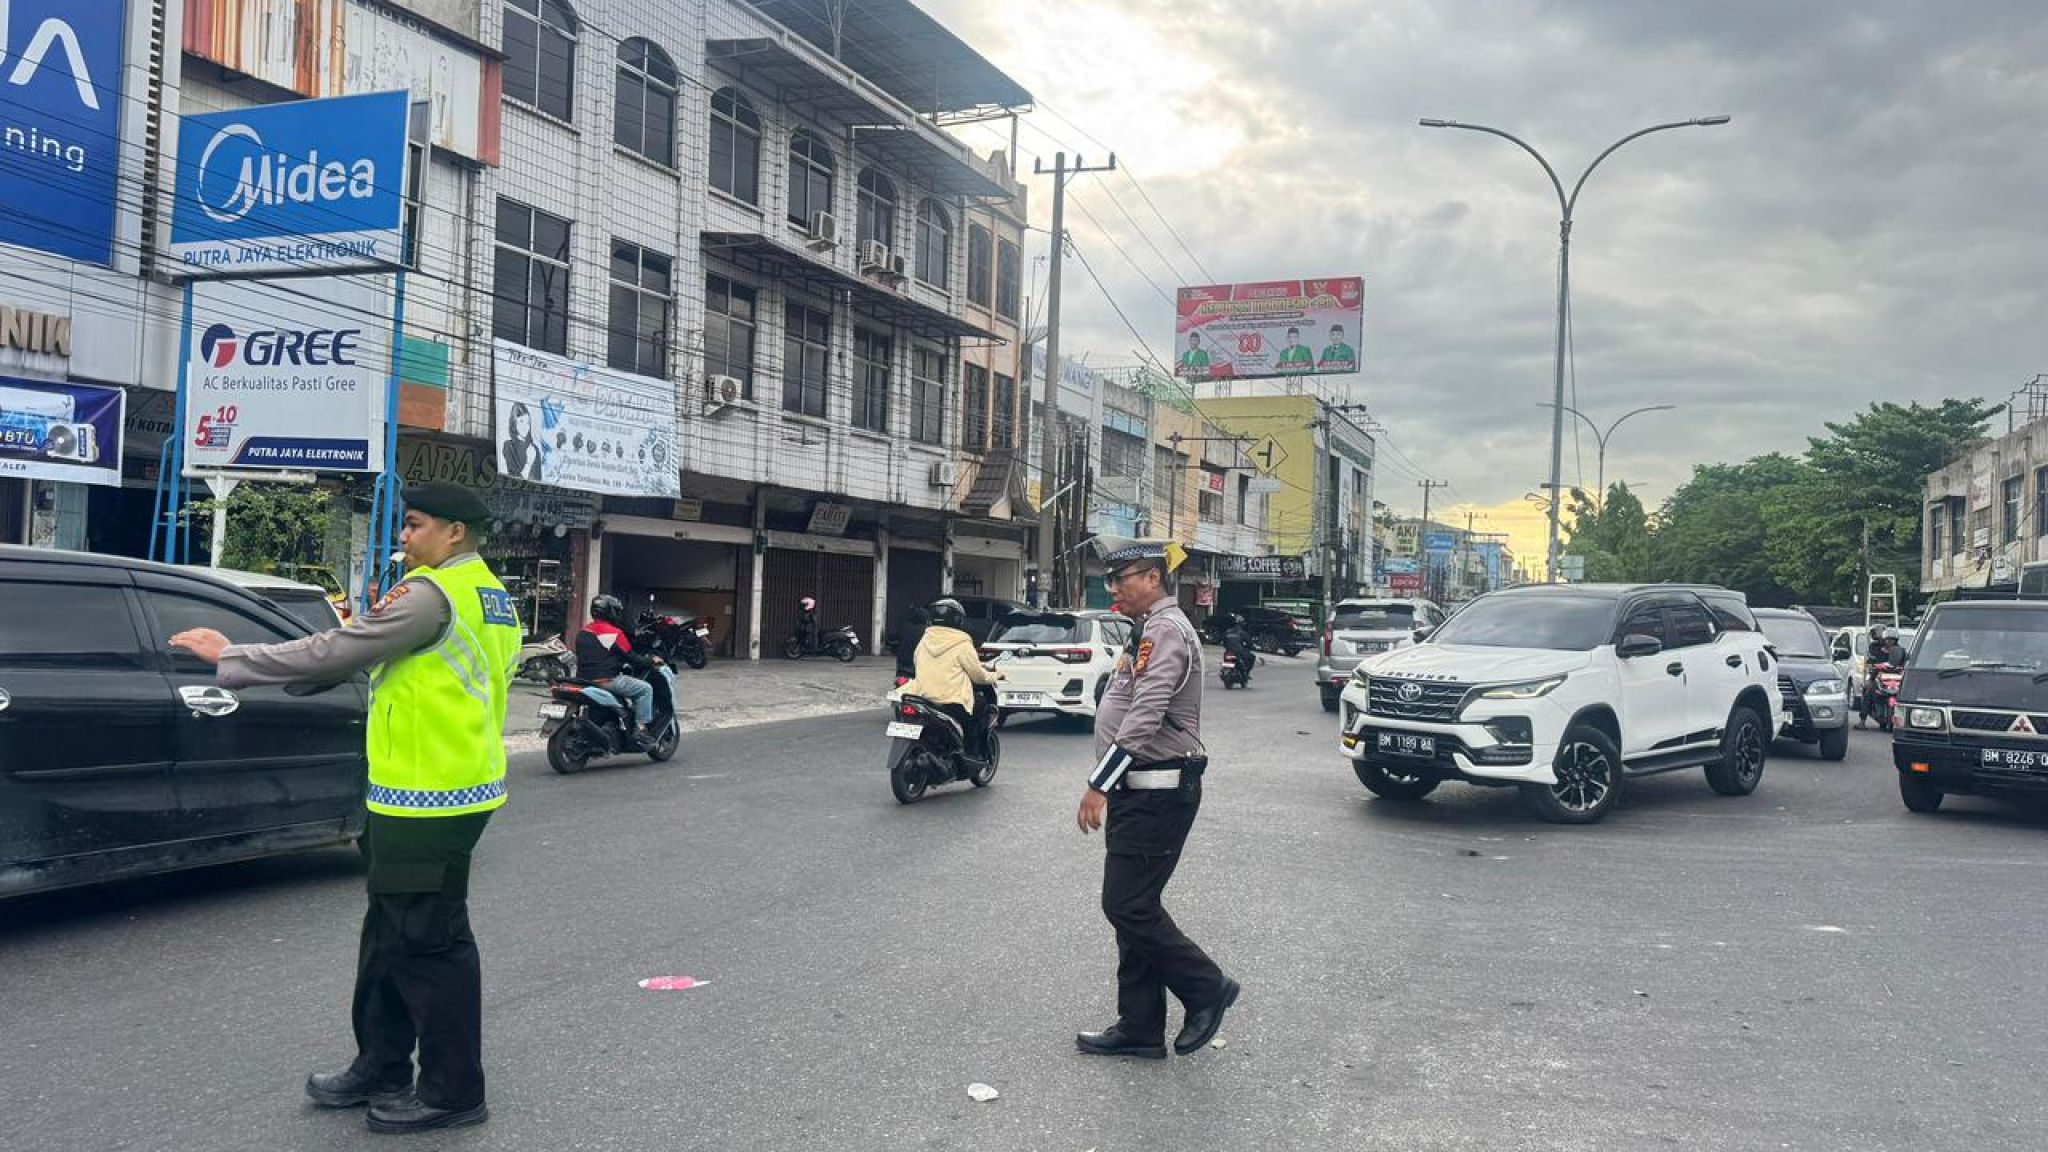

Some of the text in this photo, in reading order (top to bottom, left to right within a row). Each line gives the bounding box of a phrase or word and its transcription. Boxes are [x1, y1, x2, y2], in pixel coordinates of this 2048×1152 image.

[212, 140, 375, 215] Midea
[184, 240, 377, 266] PUTRA JAYA ELEKTRONIK
[244, 329, 361, 366] GREE
[203, 376, 357, 392] AC Berkualitas Pasti Gree
[247, 447, 364, 461] PUTRA JAYA ELEKTRONIK
[1985, 750, 1999, 762] BM
